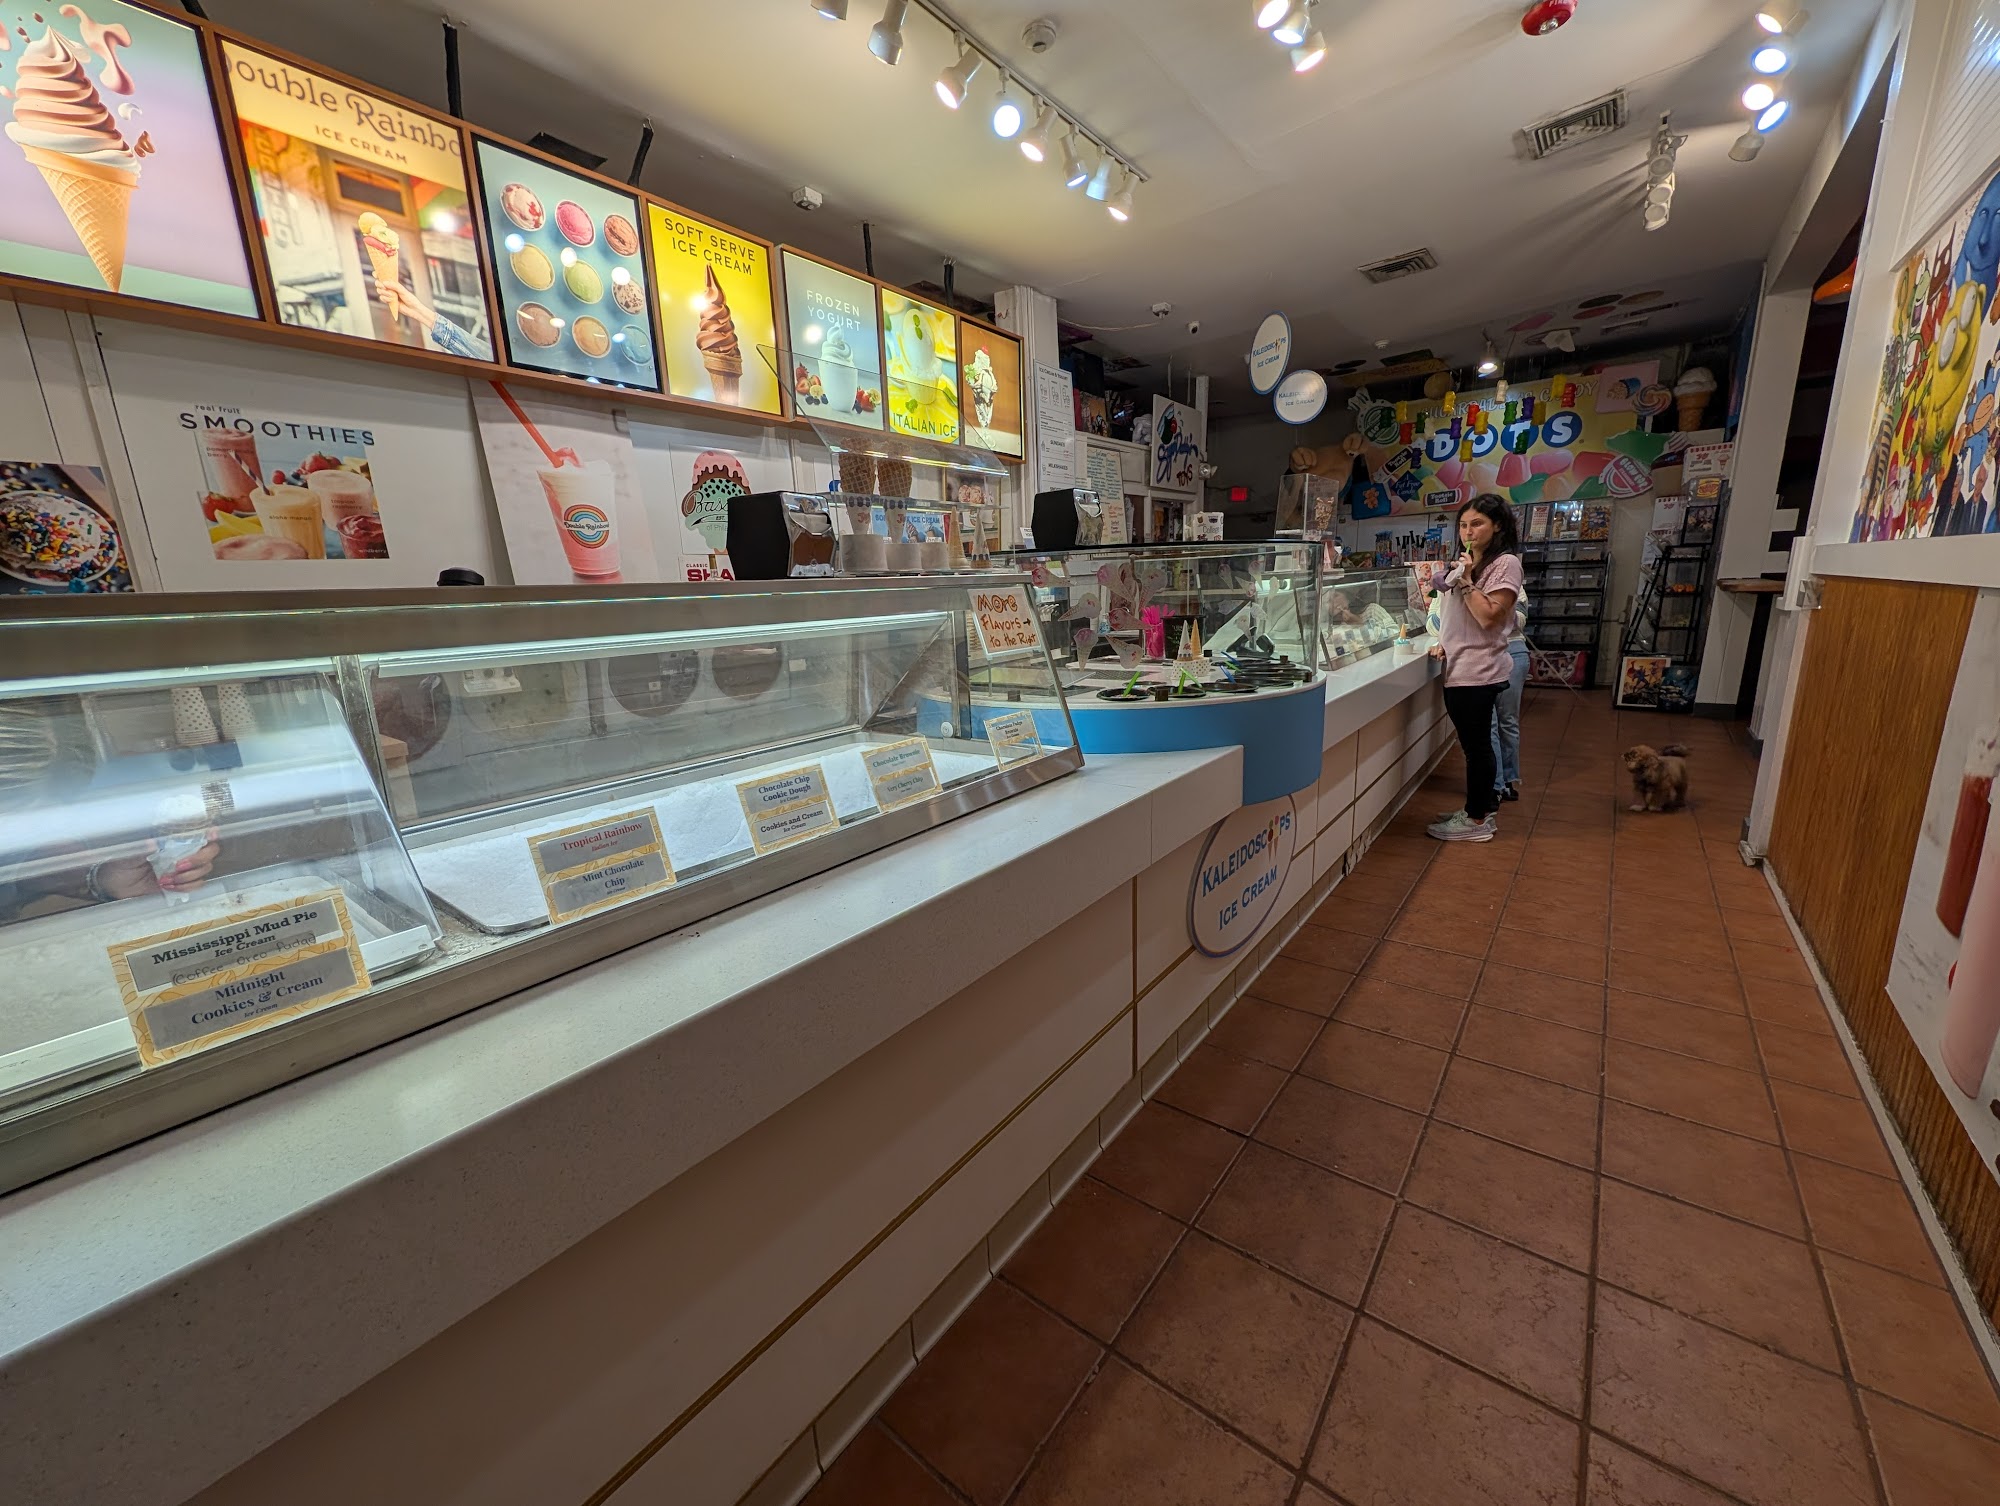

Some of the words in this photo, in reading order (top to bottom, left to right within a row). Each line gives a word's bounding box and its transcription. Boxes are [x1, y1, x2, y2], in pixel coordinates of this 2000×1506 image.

[315, 124, 344, 142] ICE
[349, 138, 409, 165] CREAM
[664, 218, 704, 243] SOFT
[710, 235, 756, 262] SERVE
[671, 237, 698, 257] ICE
[703, 249, 753, 276] CREAM
[806, 289, 861, 317] FROZEN
[807, 305, 862, 332] YOGURT
[1265, 353, 1280, 365] CREAM
[1539, 381, 1599, 403] CDY
[195, 404, 216, 413] real
[218, 405, 241, 415] fruit
[179, 412, 375, 446] SMOOTHIES
[892, 412, 936, 436] ITALIAN
[939, 423, 957, 438] ICE
[1430, 413, 1575, 460] DOTS
[1430, 492, 1454, 500] Tootsie
[911, 515, 921, 523] ICE
[921, 516, 940, 524] CREAM
[989, 633, 1001, 647] to
[1004, 631, 1017, 647] the
[1017, 632, 1037, 647] Right
[872, 755, 899, 768] Chocolate
[758, 780, 794, 794] Chocolate
[794, 775, 811, 785] Chip
[912, 776, 924, 784] Chip
[762, 790, 788, 802] Cookie
[788, 783, 812, 795] Dough
[760, 820, 788, 833] Cookies
[788, 815, 801, 825] and
[801, 810, 824, 820] Cream
[790, 822, 807, 831] Cream
[560, 832, 602, 852] Tropical
[603, 822, 643, 839] Rainbow
[582, 871, 604, 884] Mint
[604, 859, 645, 877] Chocolate
[604, 877, 625, 889] Chip
[1219, 898, 1239, 932] ICE
[1241, 865, 1278, 909] CREAM
[152, 929, 251, 965] Mississippi
[253, 917, 291, 936] Mud
[294, 909, 318, 927] Pie
[214, 946, 234, 958] Ice
[236, 935, 276, 952] Cream
[236, 950, 268, 966] Oreo
[215, 970, 286, 1001] Midnight
[191, 998, 255, 1025] Cookies
[257, 991, 272, 1003] &
[275, 975, 324, 998] Cream
[254, 1002, 279, 1015] Cream
